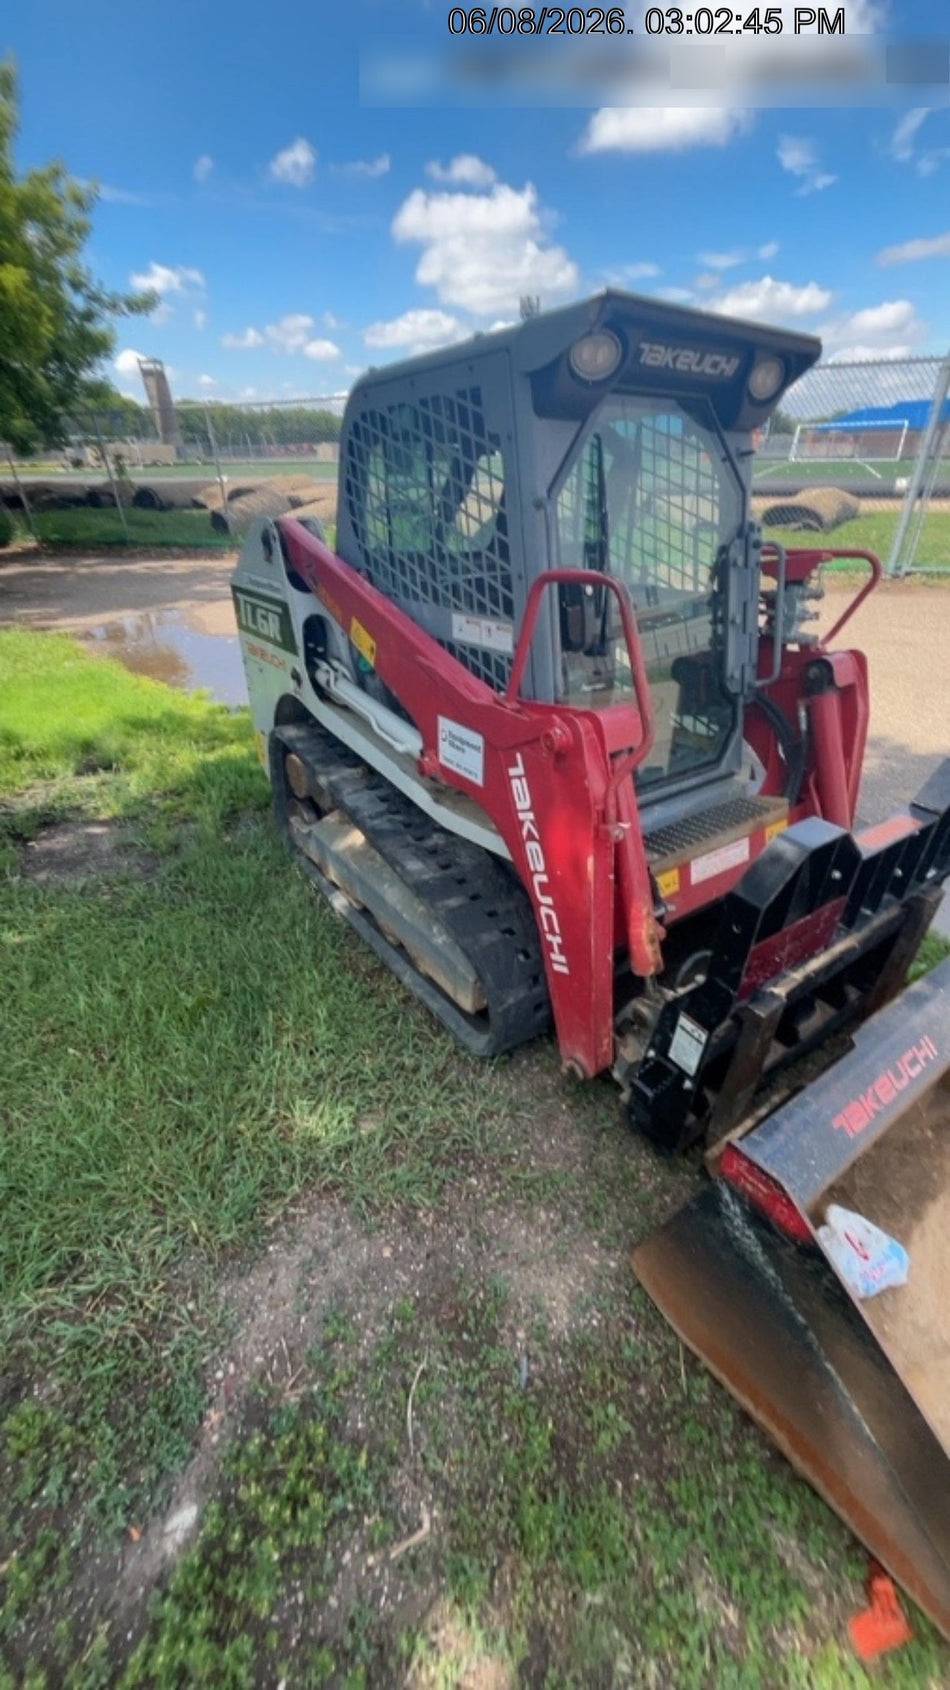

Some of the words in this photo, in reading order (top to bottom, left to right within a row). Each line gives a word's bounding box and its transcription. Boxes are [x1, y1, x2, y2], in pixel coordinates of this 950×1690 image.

[640, 342, 740, 377] TAKEUCHI
[508, 752, 570, 975] TAKEUCHI
[832, 1035, 937, 1137] TAKEUCHI
